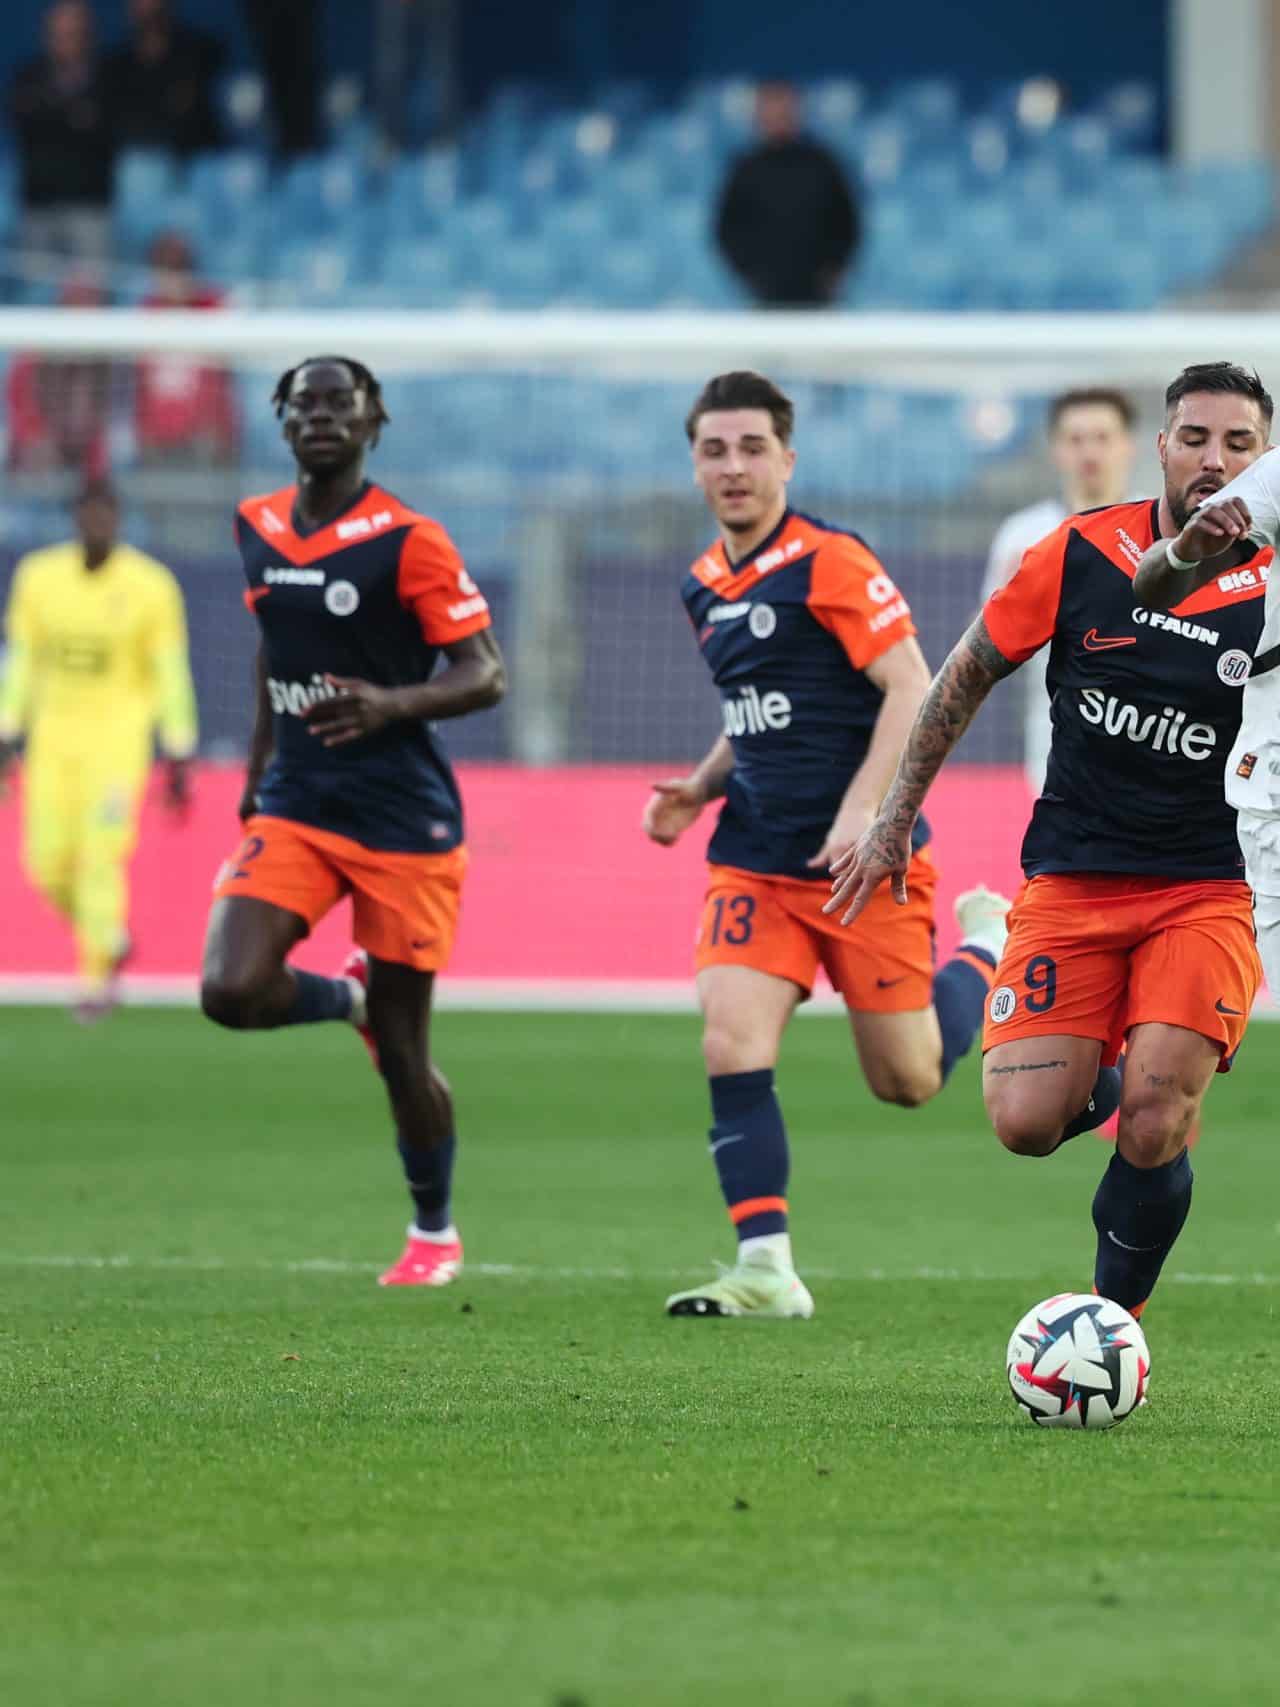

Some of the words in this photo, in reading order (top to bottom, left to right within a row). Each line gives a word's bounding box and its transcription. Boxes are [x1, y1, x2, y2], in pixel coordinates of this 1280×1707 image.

[1149, 611, 1220, 647] FAUN
[1223, 656, 1247, 680] 50
[711, 895, 756, 946] 13
[1024, 955, 1057, 1013] 9
